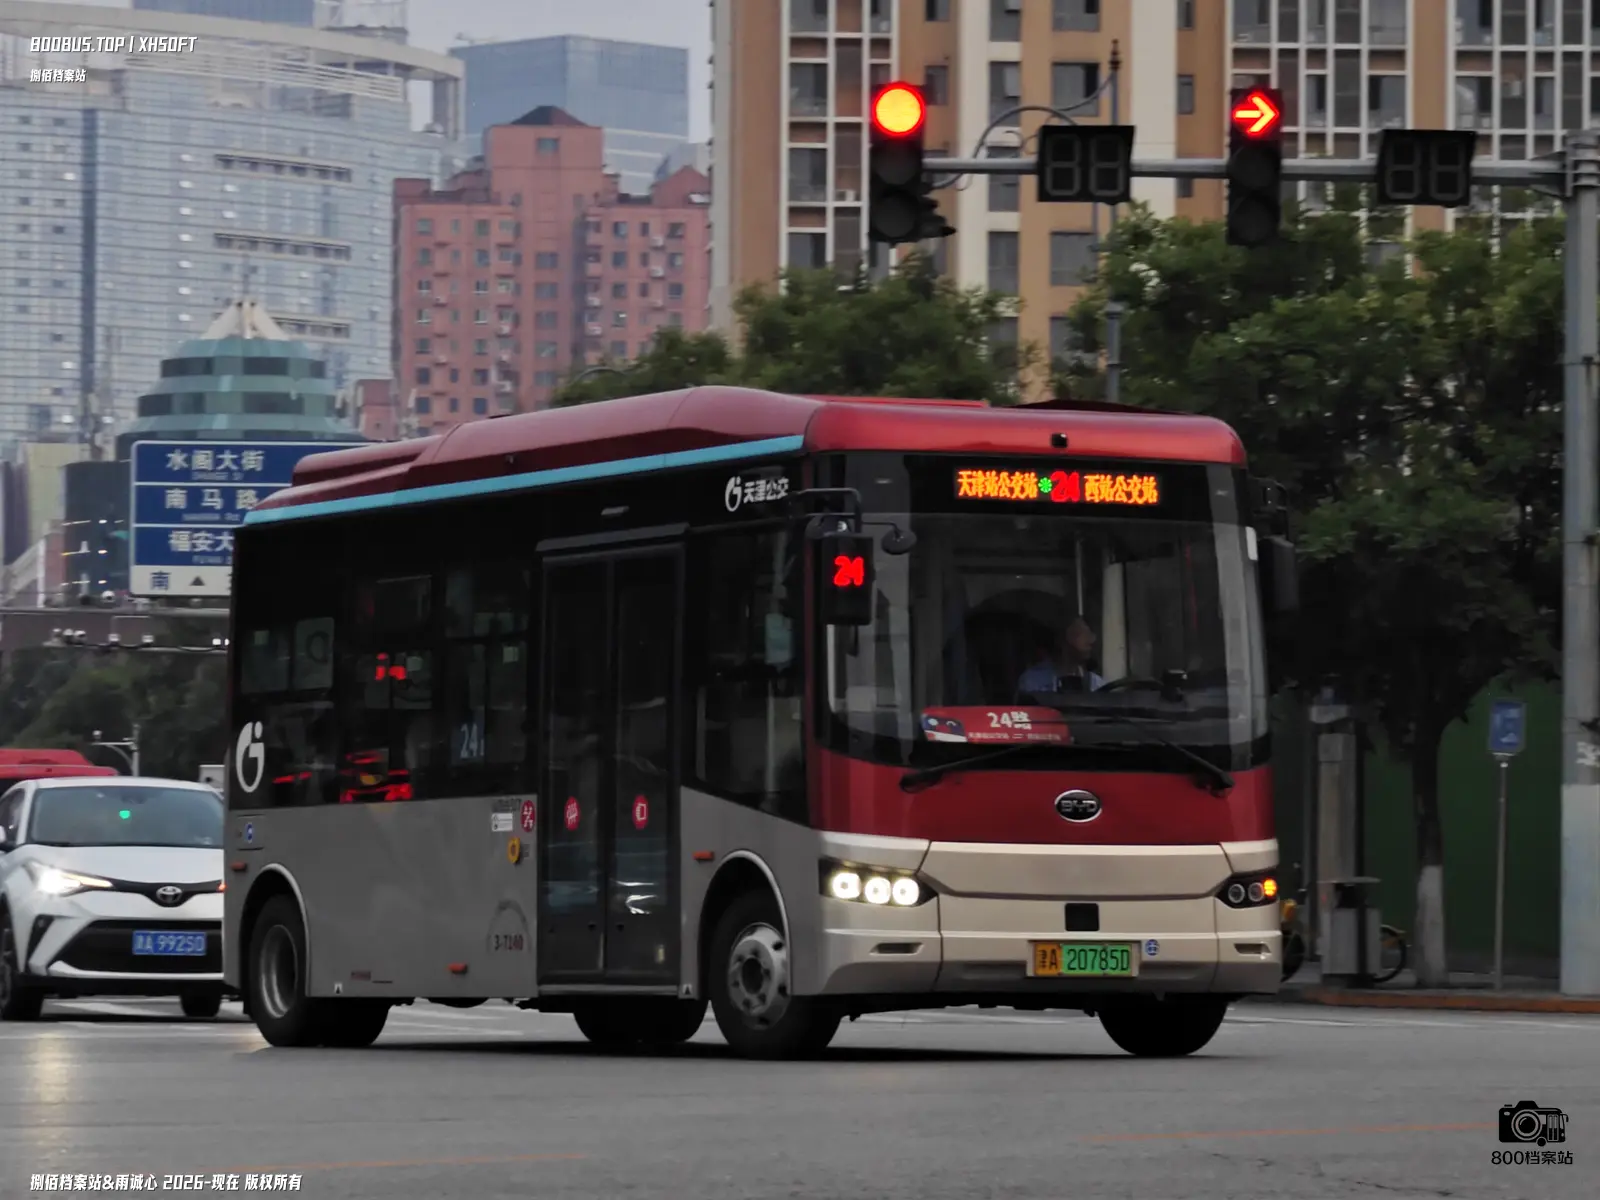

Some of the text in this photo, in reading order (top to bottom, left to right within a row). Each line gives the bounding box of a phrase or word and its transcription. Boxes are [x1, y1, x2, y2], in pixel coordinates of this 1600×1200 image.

[165, 488, 259, 510] 南马路
[1051, 470, 1080, 502] 24
[151, 571, 170, 590] 南
[834, 555, 864, 587] 24
